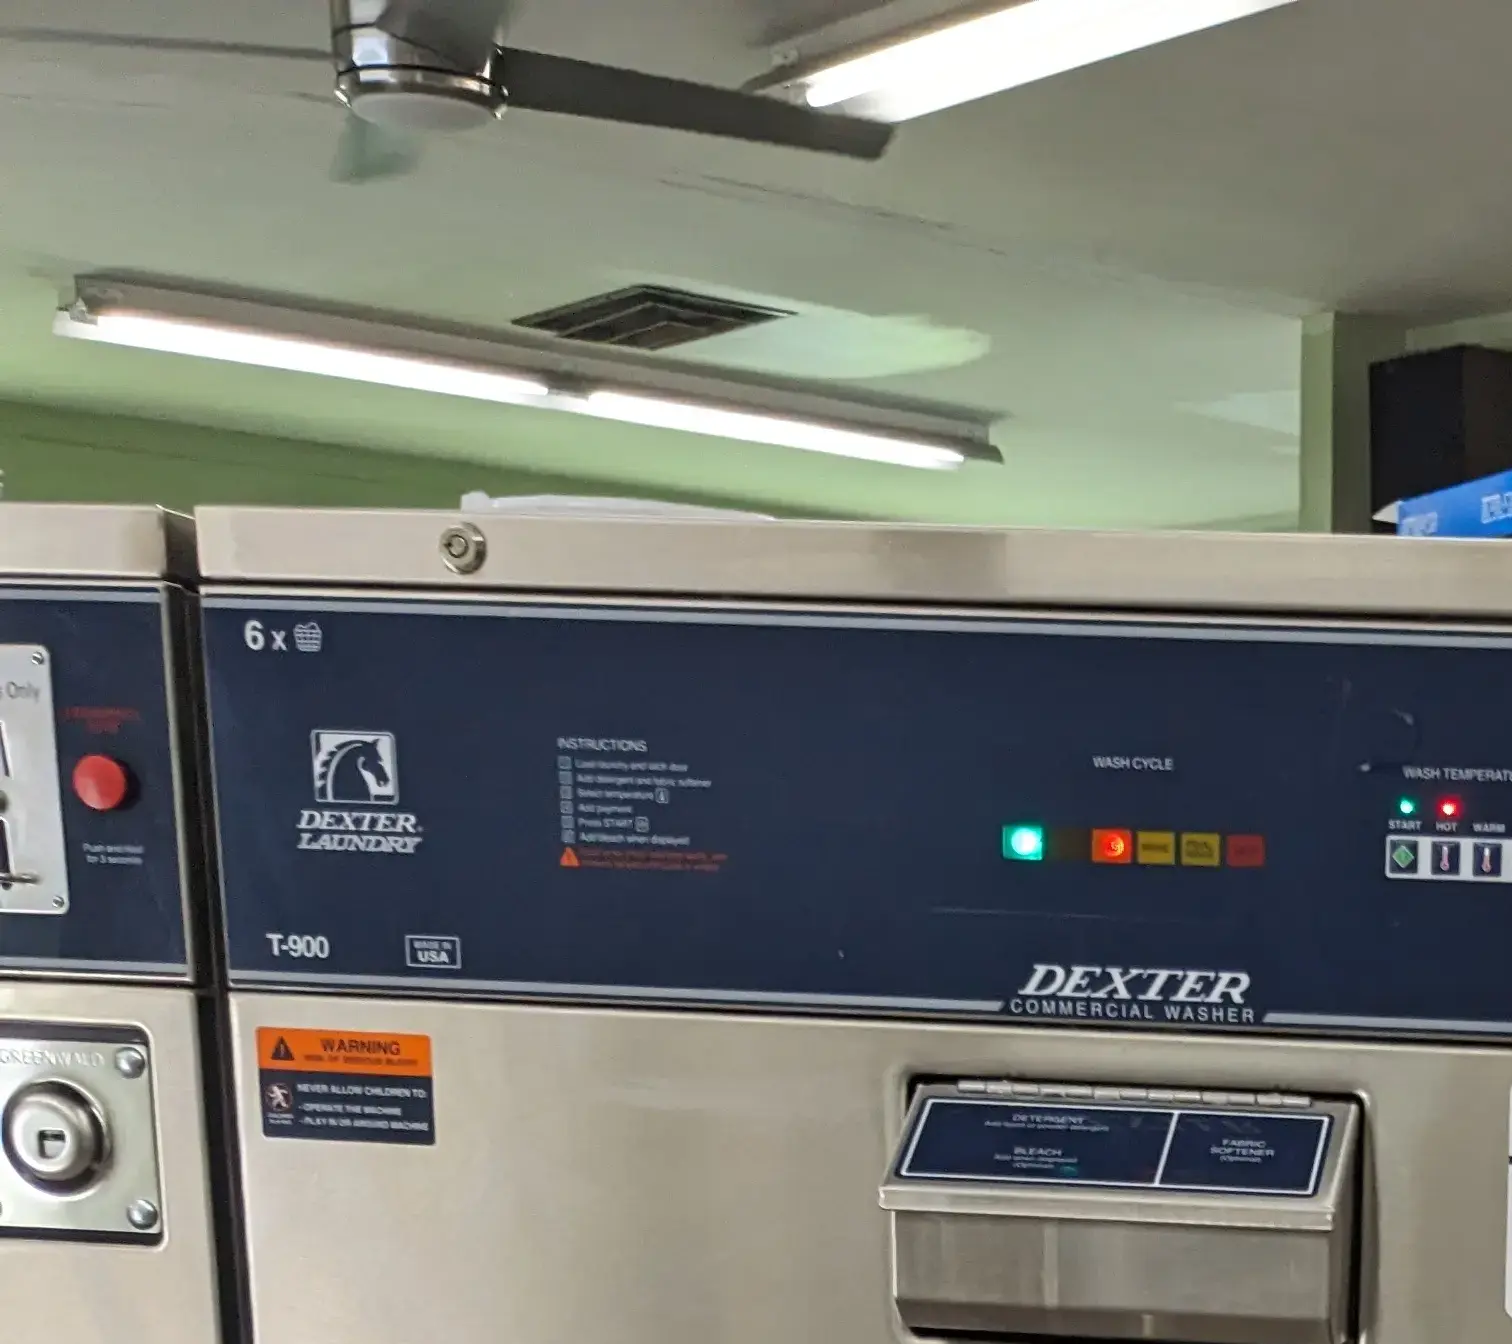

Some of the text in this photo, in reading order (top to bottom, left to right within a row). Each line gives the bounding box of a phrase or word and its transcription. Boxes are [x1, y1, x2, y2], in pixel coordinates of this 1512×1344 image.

[244, 619, 265, 651] 6
[557, 737, 648, 752] INSTRUCTIONS
[1092, 755, 1174, 772] WASH CYCLE
[1402, 765, 1440, 780] WASH
[296, 809, 419, 834] DEXTER
[1388, 818, 1422, 832] START
[1435, 821, 1458, 833] HOT
[1472, 823, 1506, 834] WARM
[297, 832, 423, 853] LAUNDRY
[266, 933, 330, 959] T-900
[416, 950, 449, 964] USA
[1018, 963, 1251, 1004] DEXTER
[1010, 998, 1255, 1023] COMMERCIAL WASHER
[320, 1038, 401, 1056] WARNING
